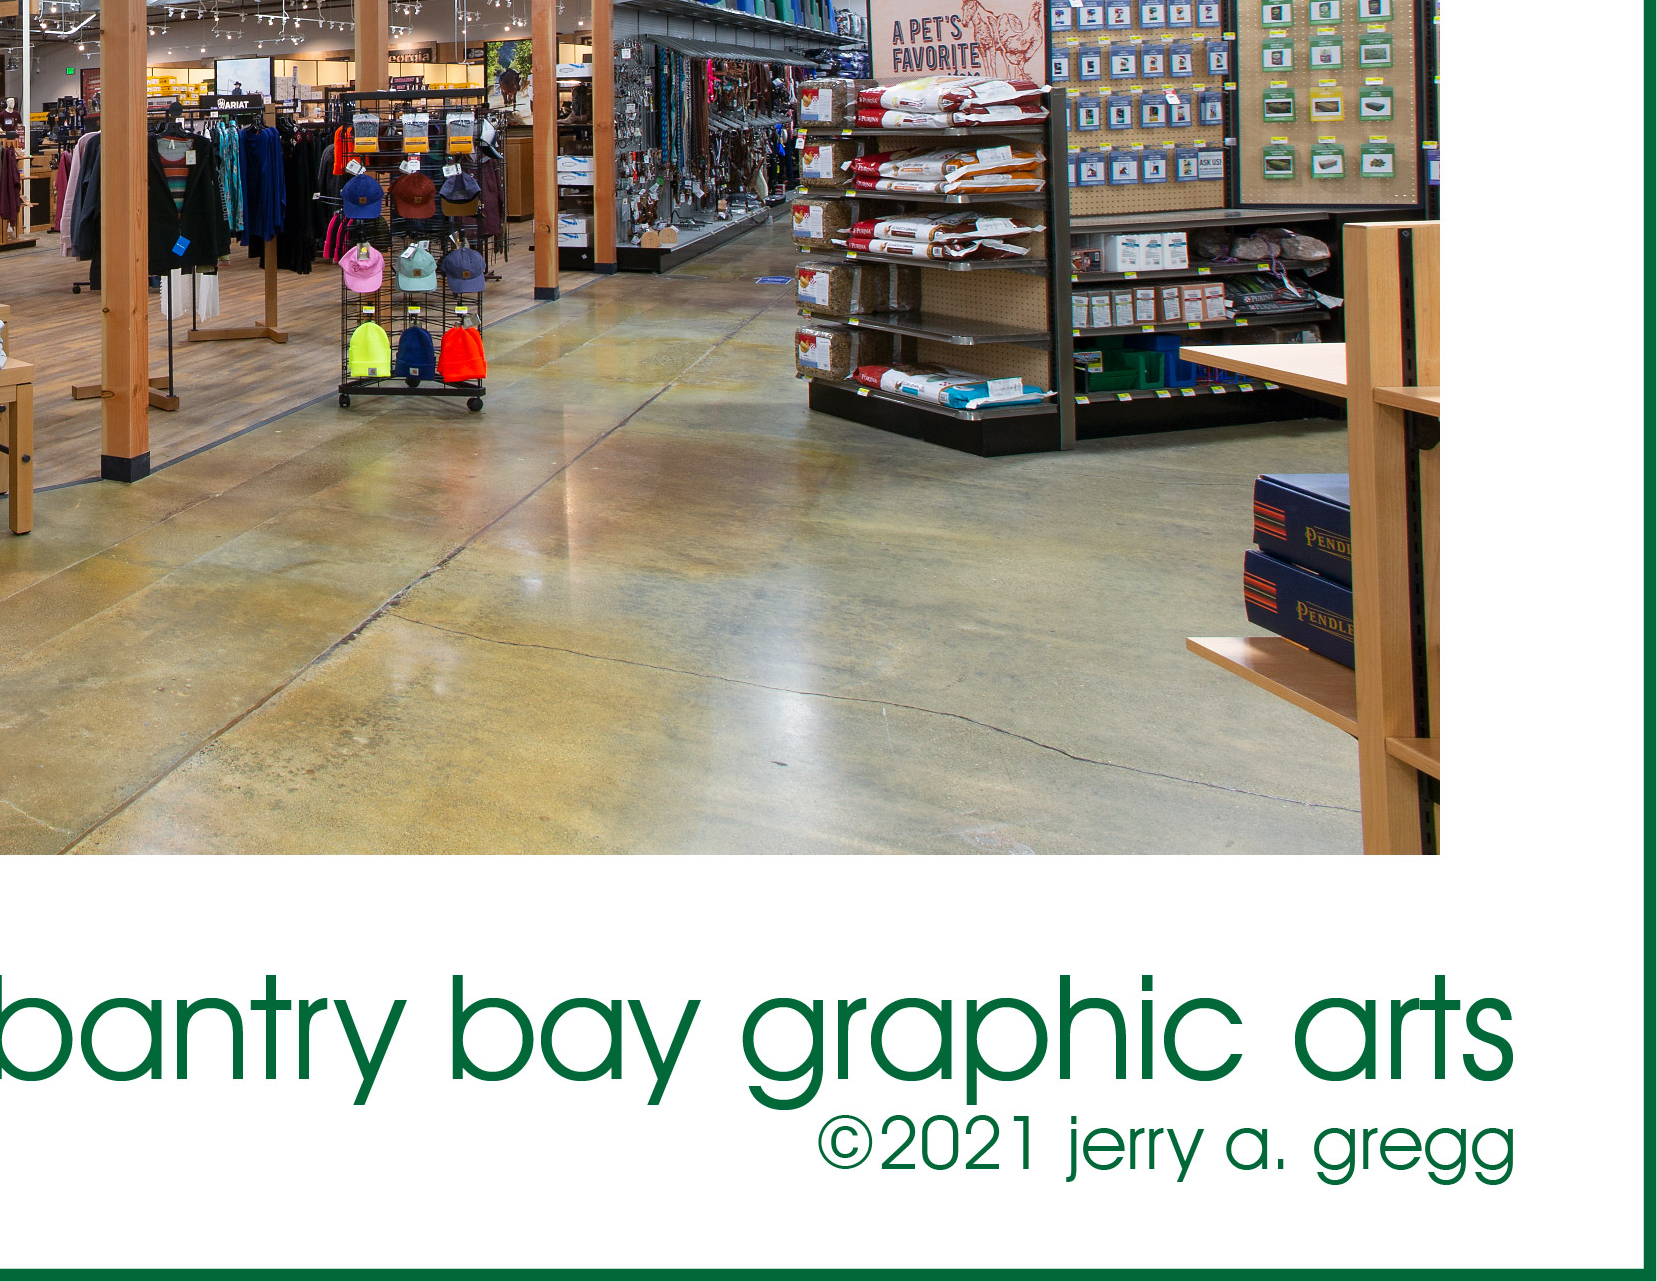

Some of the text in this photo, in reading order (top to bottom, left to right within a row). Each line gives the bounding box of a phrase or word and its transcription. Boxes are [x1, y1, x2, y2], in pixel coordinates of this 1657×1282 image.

[892, 14, 962, 45] A PET'S
[892, 42, 982, 72] FAVORITE
[224, 101, 250, 109] ARIAT
[1199, 158, 1222, 166] ASK US!
[1296, 601, 1354, 636] PENDLE
